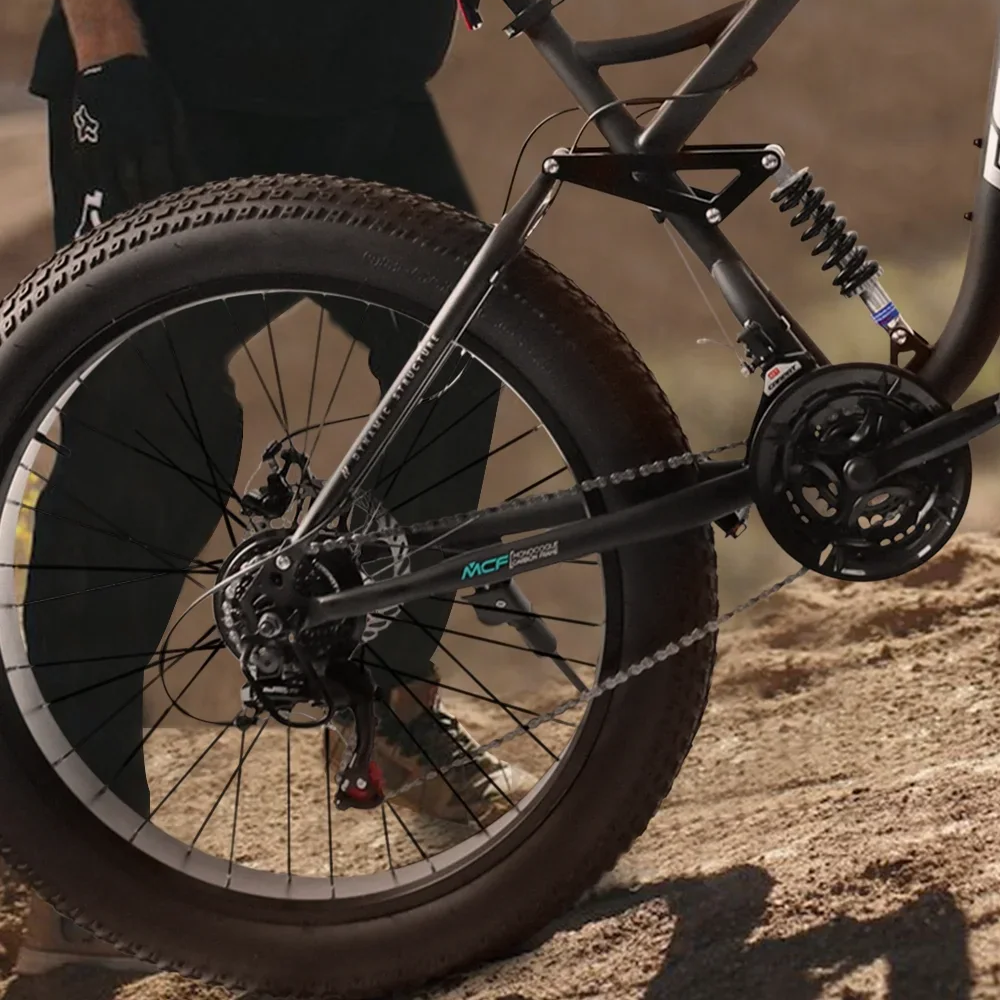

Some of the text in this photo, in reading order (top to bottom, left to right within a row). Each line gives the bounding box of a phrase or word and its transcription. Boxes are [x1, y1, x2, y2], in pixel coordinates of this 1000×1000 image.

[352, 406, 391, 461] DYNAMIC
[392, 334, 440, 400] STRUCTURE
[461, 554, 509, 580] MCF
